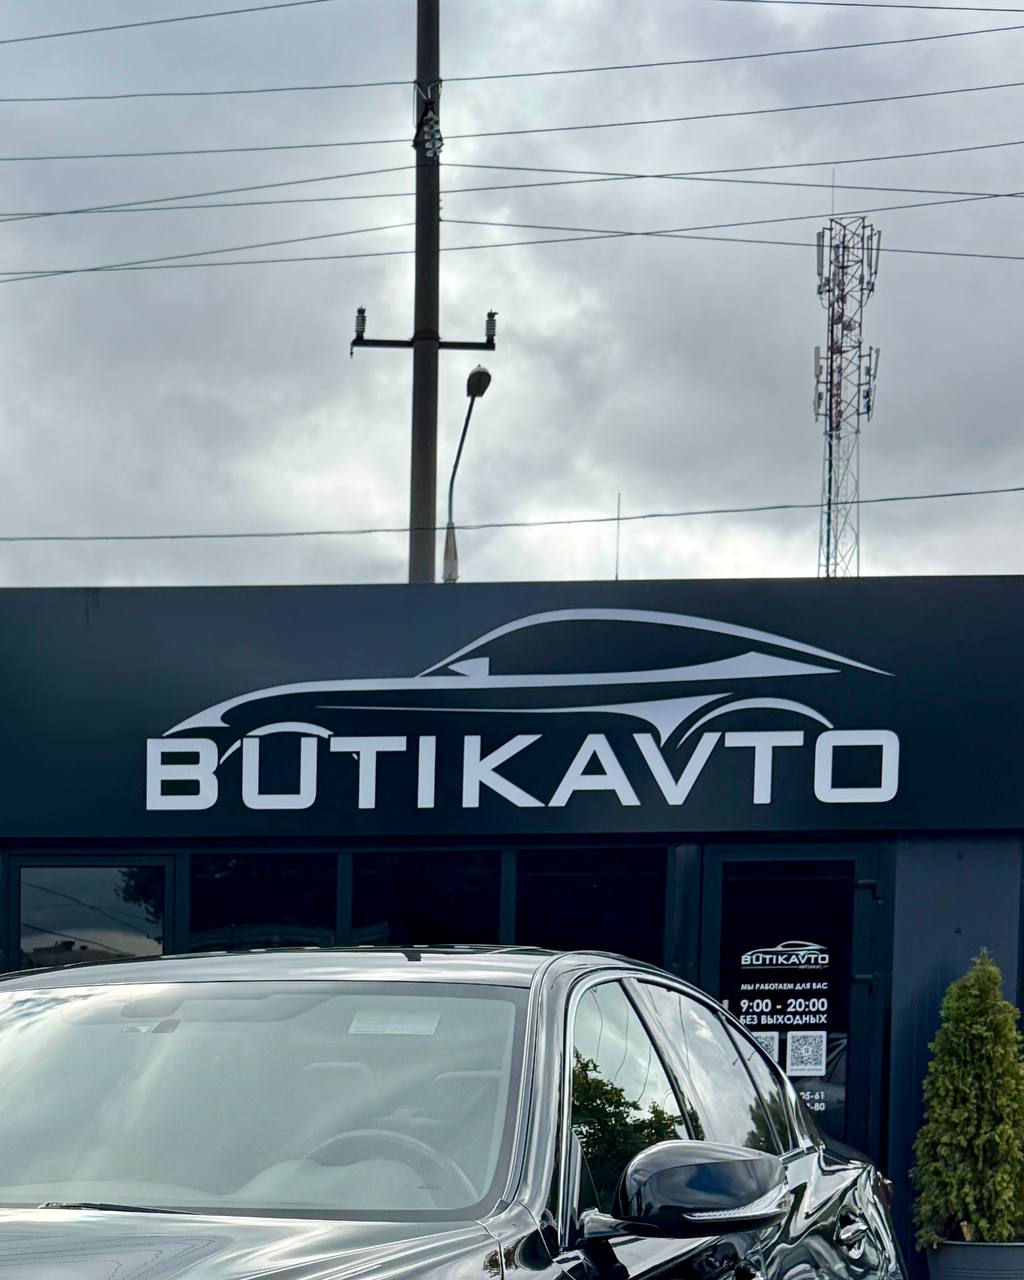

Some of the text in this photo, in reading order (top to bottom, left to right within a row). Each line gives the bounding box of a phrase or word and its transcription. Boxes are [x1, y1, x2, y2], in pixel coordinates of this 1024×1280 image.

[146, 729, 901, 811] BUTIKAVTO
[741, 954, 829, 965] BUTIKAVTO
[740, 983, 754, 991] МЫ
[795, 982, 811, 990] ДЛЯ
[812, 982, 828, 990] ВАС
[740, 999, 772, 1012] 9:00
[786, 998, 828, 1012] 20:00
[740, 1014, 828, 1025] БЕЗ ВЫХОДНЫХ
